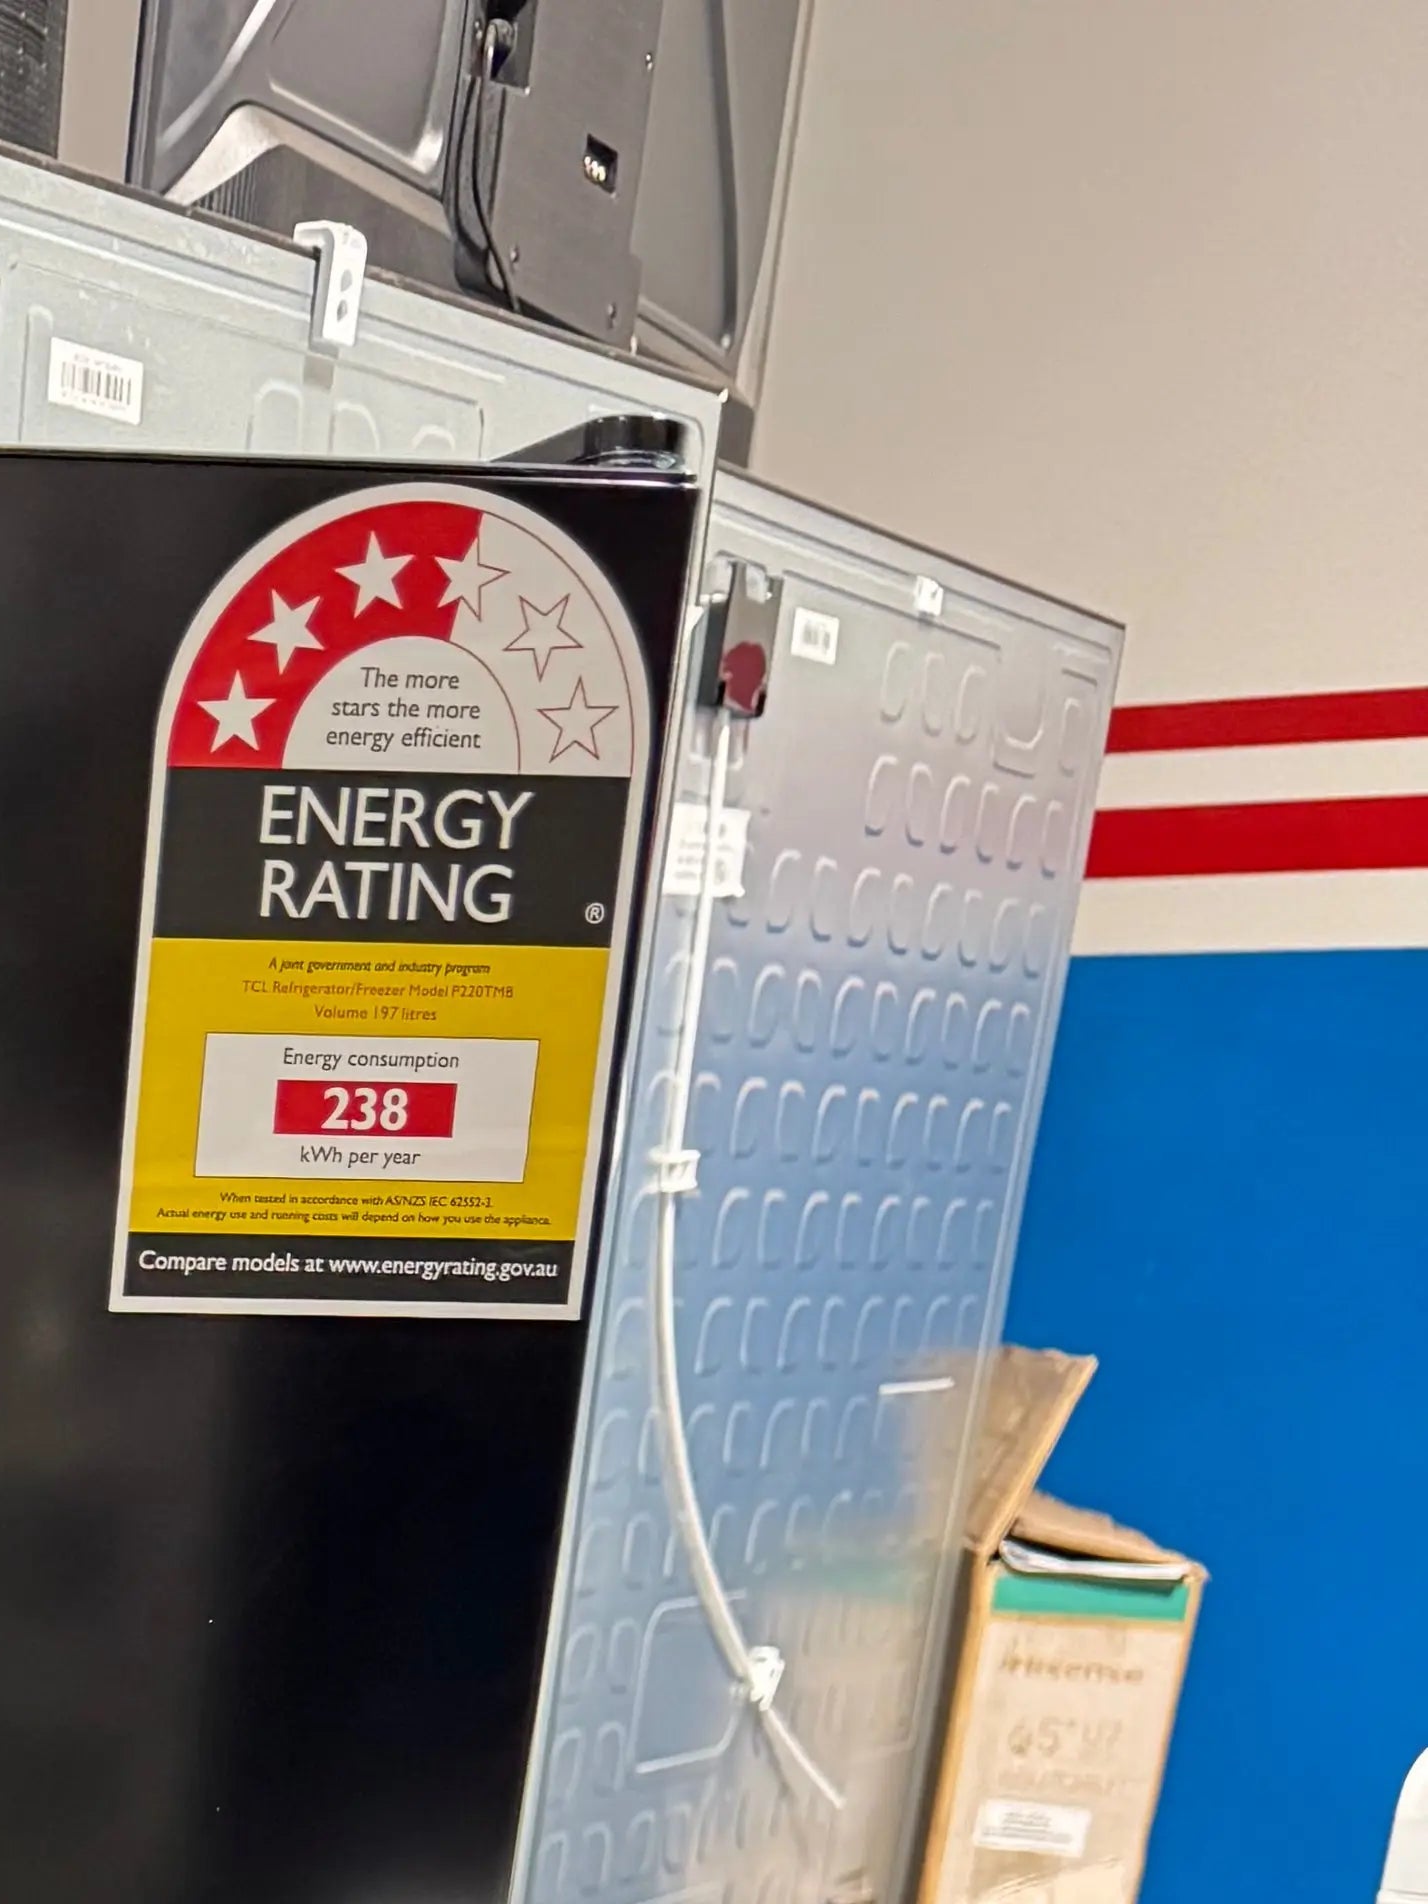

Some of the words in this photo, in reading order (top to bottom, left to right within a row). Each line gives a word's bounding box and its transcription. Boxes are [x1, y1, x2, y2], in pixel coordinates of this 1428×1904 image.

[360, 666, 398, 687] The
[405, 674, 460, 689] more
[331, 701, 380, 717] stars
[388, 698, 420, 717] the
[427, 703, 480, 719] more
[326, 729, 394, 752] energy
[401, 727, 481, 748] efficient
[259, 784, 535, 850] ENERGY
[259, 858, 514, 924] RATING
[268, 956, 277, 970] A
[279, 960, 304, 973] joint
[307, 960, 371, 975] government
[375, 961, 396, 973] and
[399, 962, 442, 977] industry
[445, 963, 491, 977] program
[242, 980, 268, 994] TCL
[272, 980, 404, 998] Refrigerator/Freezer
[409, 984, 448, 998] Model
[452, 985, 514, 998] P220TMB
[314, 1005, 368, 1020] Volume
[374, 1006, 399, 1021] 197
[401, 1007, 438, 1021] litres
[283, 1047, 342, 1071] Energy
[347, 1051, 460, 1072] consumption
[320, 1086, 409, 1132] 238
[300, 1145, 343, 1164] kWh
[348, 1151, 379, 1168] per
[383, 1152, 422, 1169] year
[220, 1192, 251, 1203] When
[254, 1193, 286, 1205] tested
[289, 1193, 298, 1204] in
[300, 1193, 358, 1206] accordance
[361, 1195, 383, 1206] with
[157, 1207, 189, 1218] Actual
[192, 1209, 227, 1221] energy
[230, 1210, 247, 1219] use
[250, 1209, 268, 1220] and
[271, 1210, 310, 1223] running
[341, 1211, 359, 1221] will
[362, 1212, 399, 1224] depend
[402, 1214, 415, 1223] on
[418, 1213, 440, 1223] how
[443, 1215, 461, 1226] you
[464, 1215, 482, 1224] use
[484, 1214, 500, 1225] the
[138, 1250, 226, 1275] Compare
[232, 1252, 299, 1273] models
[304, 1257, 325, 1272] at
[329, 1257, 559, 1281] www.energyrating.gov.au
